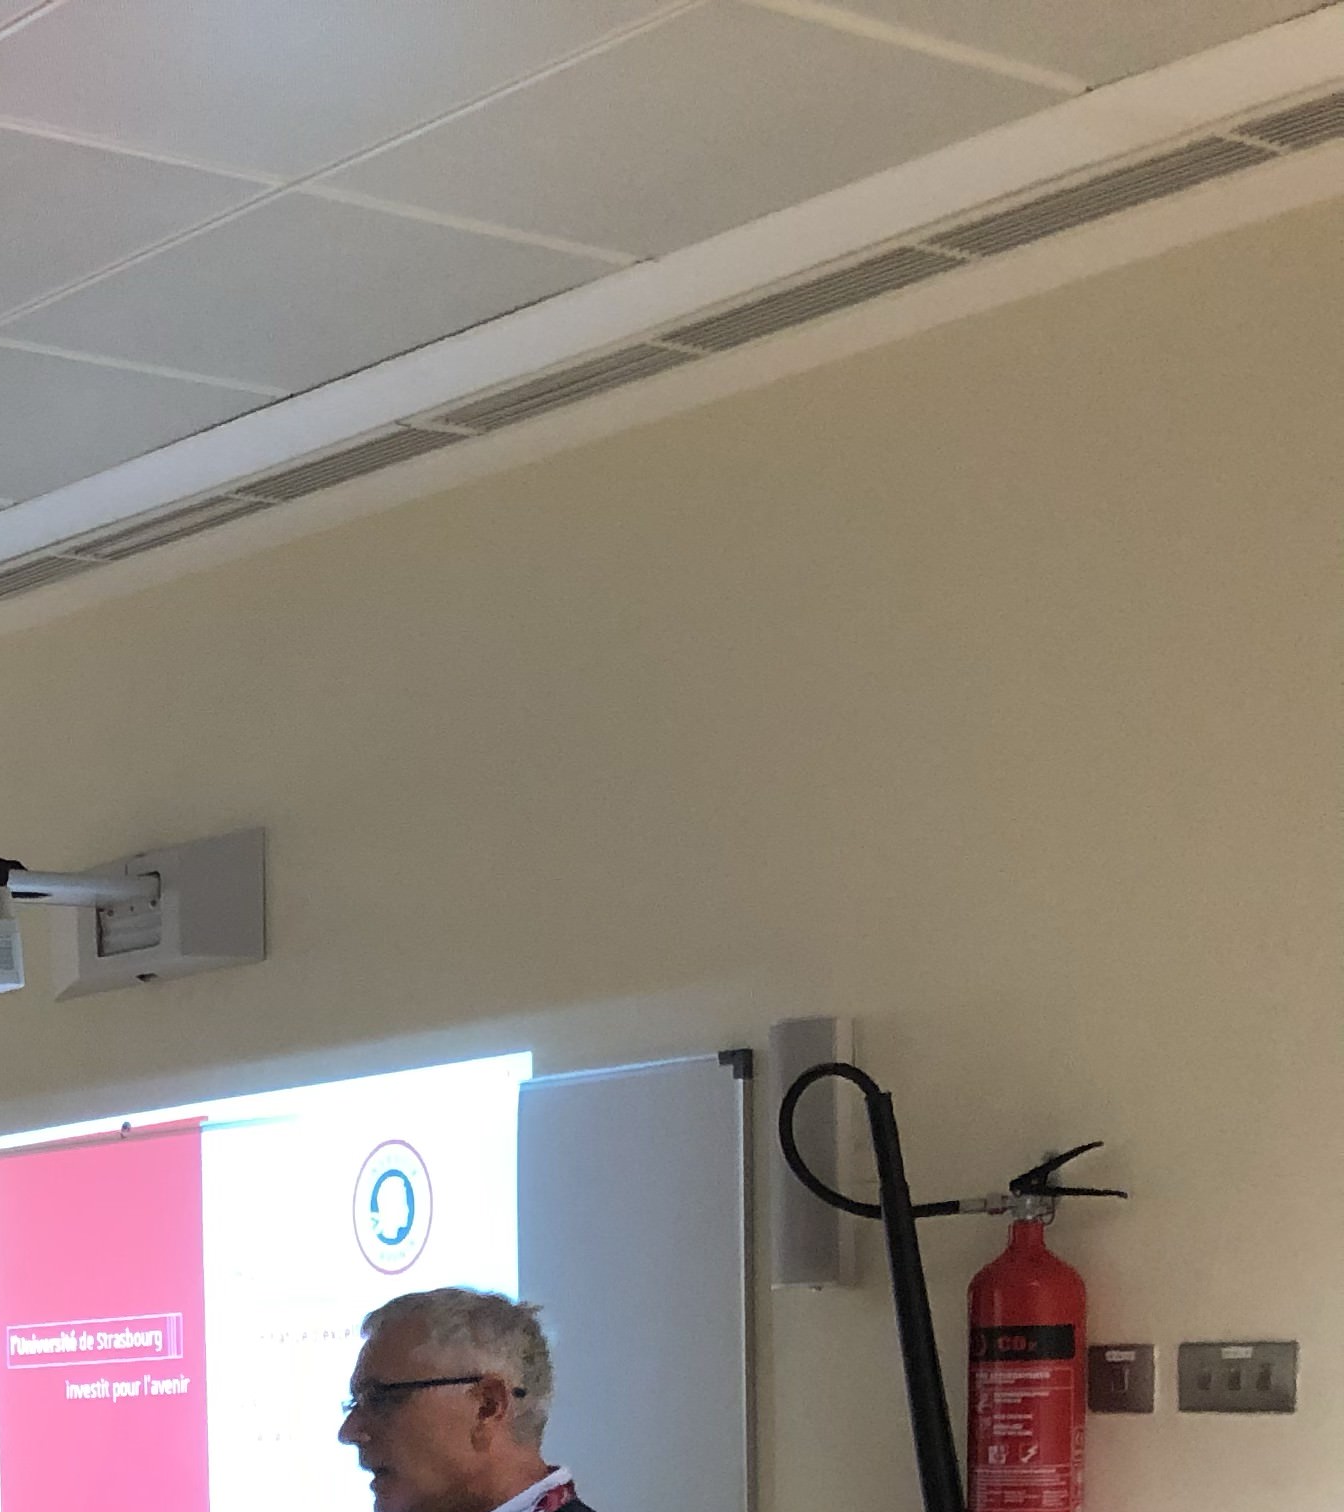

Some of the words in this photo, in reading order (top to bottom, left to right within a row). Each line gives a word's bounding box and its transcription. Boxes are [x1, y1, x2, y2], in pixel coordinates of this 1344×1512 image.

[79, 1331, 94, 1351] de
[97, 1327, 163, 1352] Strasbourg
[65, 1378, 110, 1400] investit
[112, 1380, 141, 1403] pour
[143, 1374, 190, 1396] l'avenir
